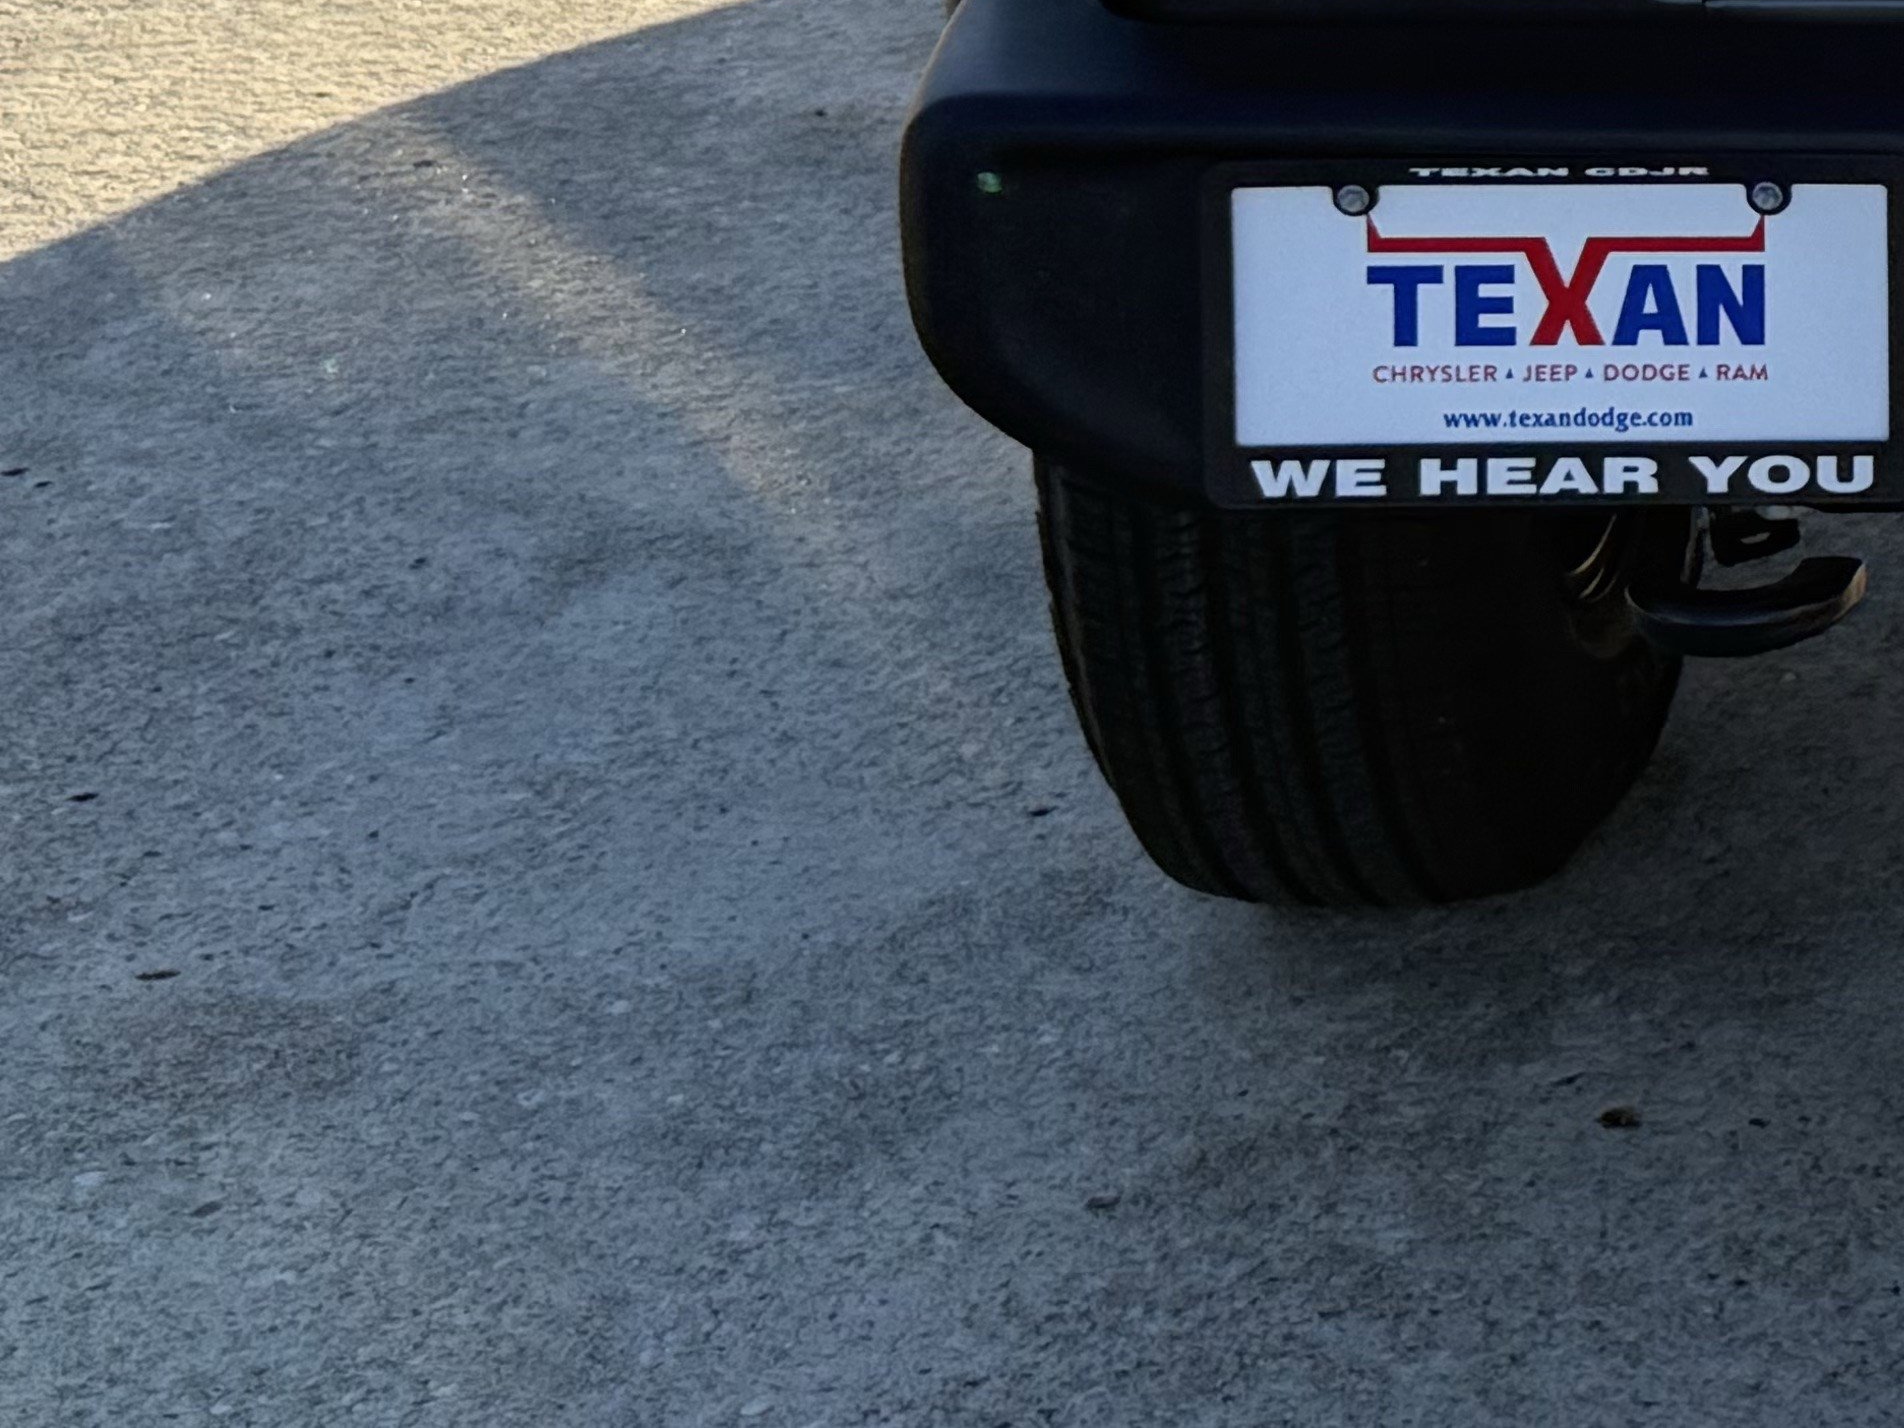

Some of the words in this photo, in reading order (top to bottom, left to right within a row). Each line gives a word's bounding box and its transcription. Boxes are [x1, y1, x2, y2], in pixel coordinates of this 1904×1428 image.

[1409, 166, 1569, 178] TEXAN
[1367, 237, 1766, 347] TEXAN
[1372, 364, 1498, 383] CHRYSLER
[1523, 364, 1579, 382] JEEP
[1603, 363, 1691, 382] DODGE
[1716, 363, 1769, 382] RAM
[1444, 406, 1694, 432] www.texandodge.com
[1251, 457, 1388, 498] WE
[1418, 456, 1660, 497] HEAR
[1689, 454, 1876, 495] YOU
